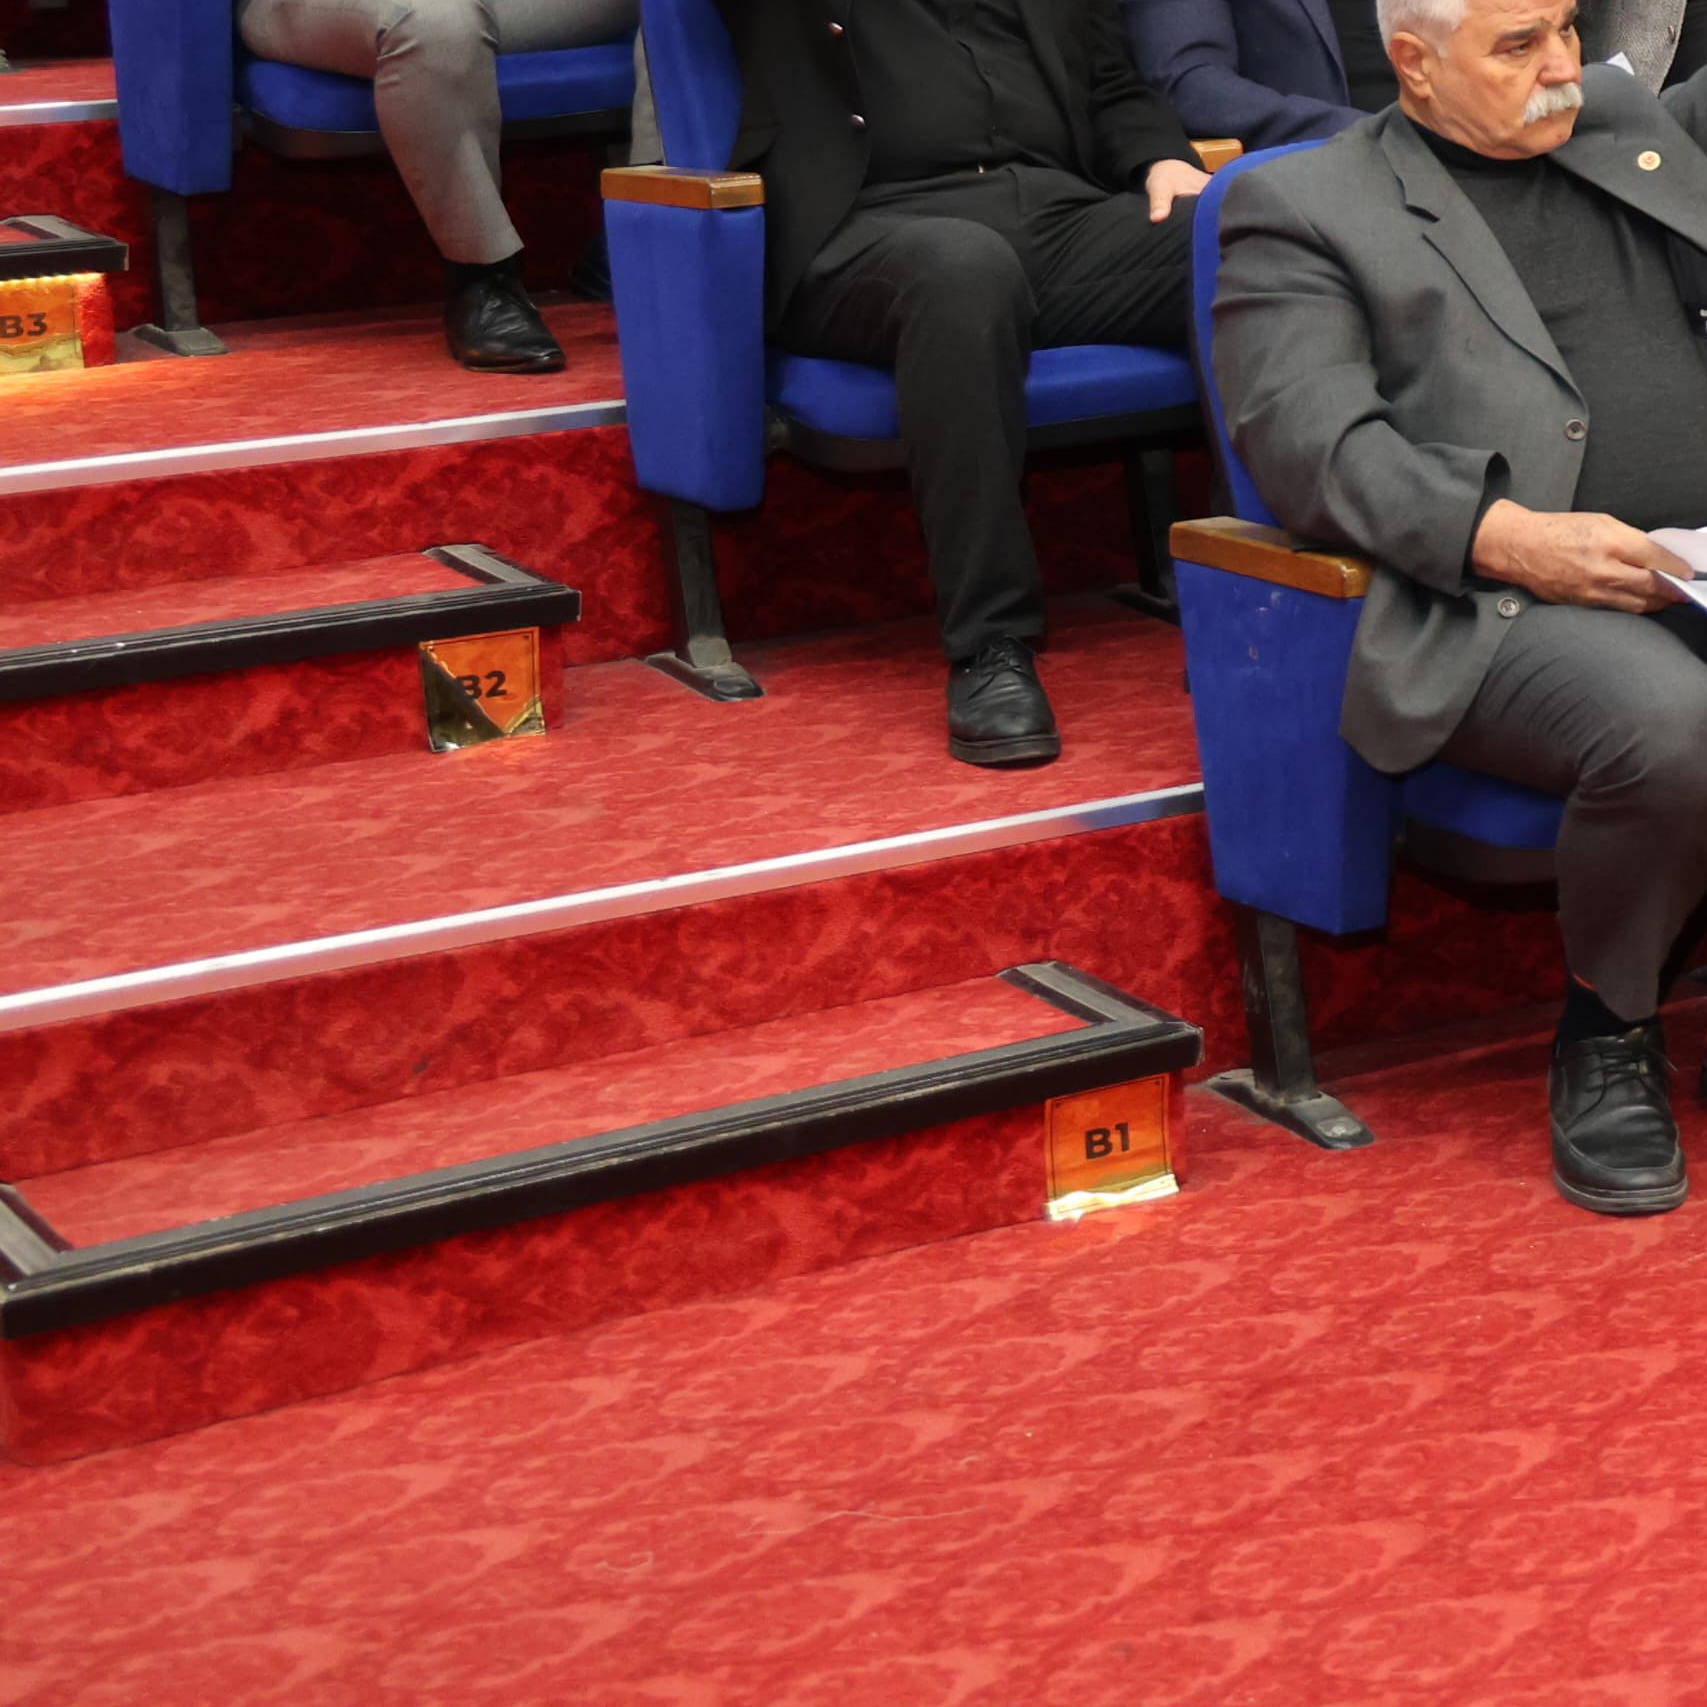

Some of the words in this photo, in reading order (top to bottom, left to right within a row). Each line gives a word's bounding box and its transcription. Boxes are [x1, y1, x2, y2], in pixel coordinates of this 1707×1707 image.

[0, 312, 48, 339] B3
[456, 670, 507, 699] B2
[1085, 1122, 1130, 1161] B1
